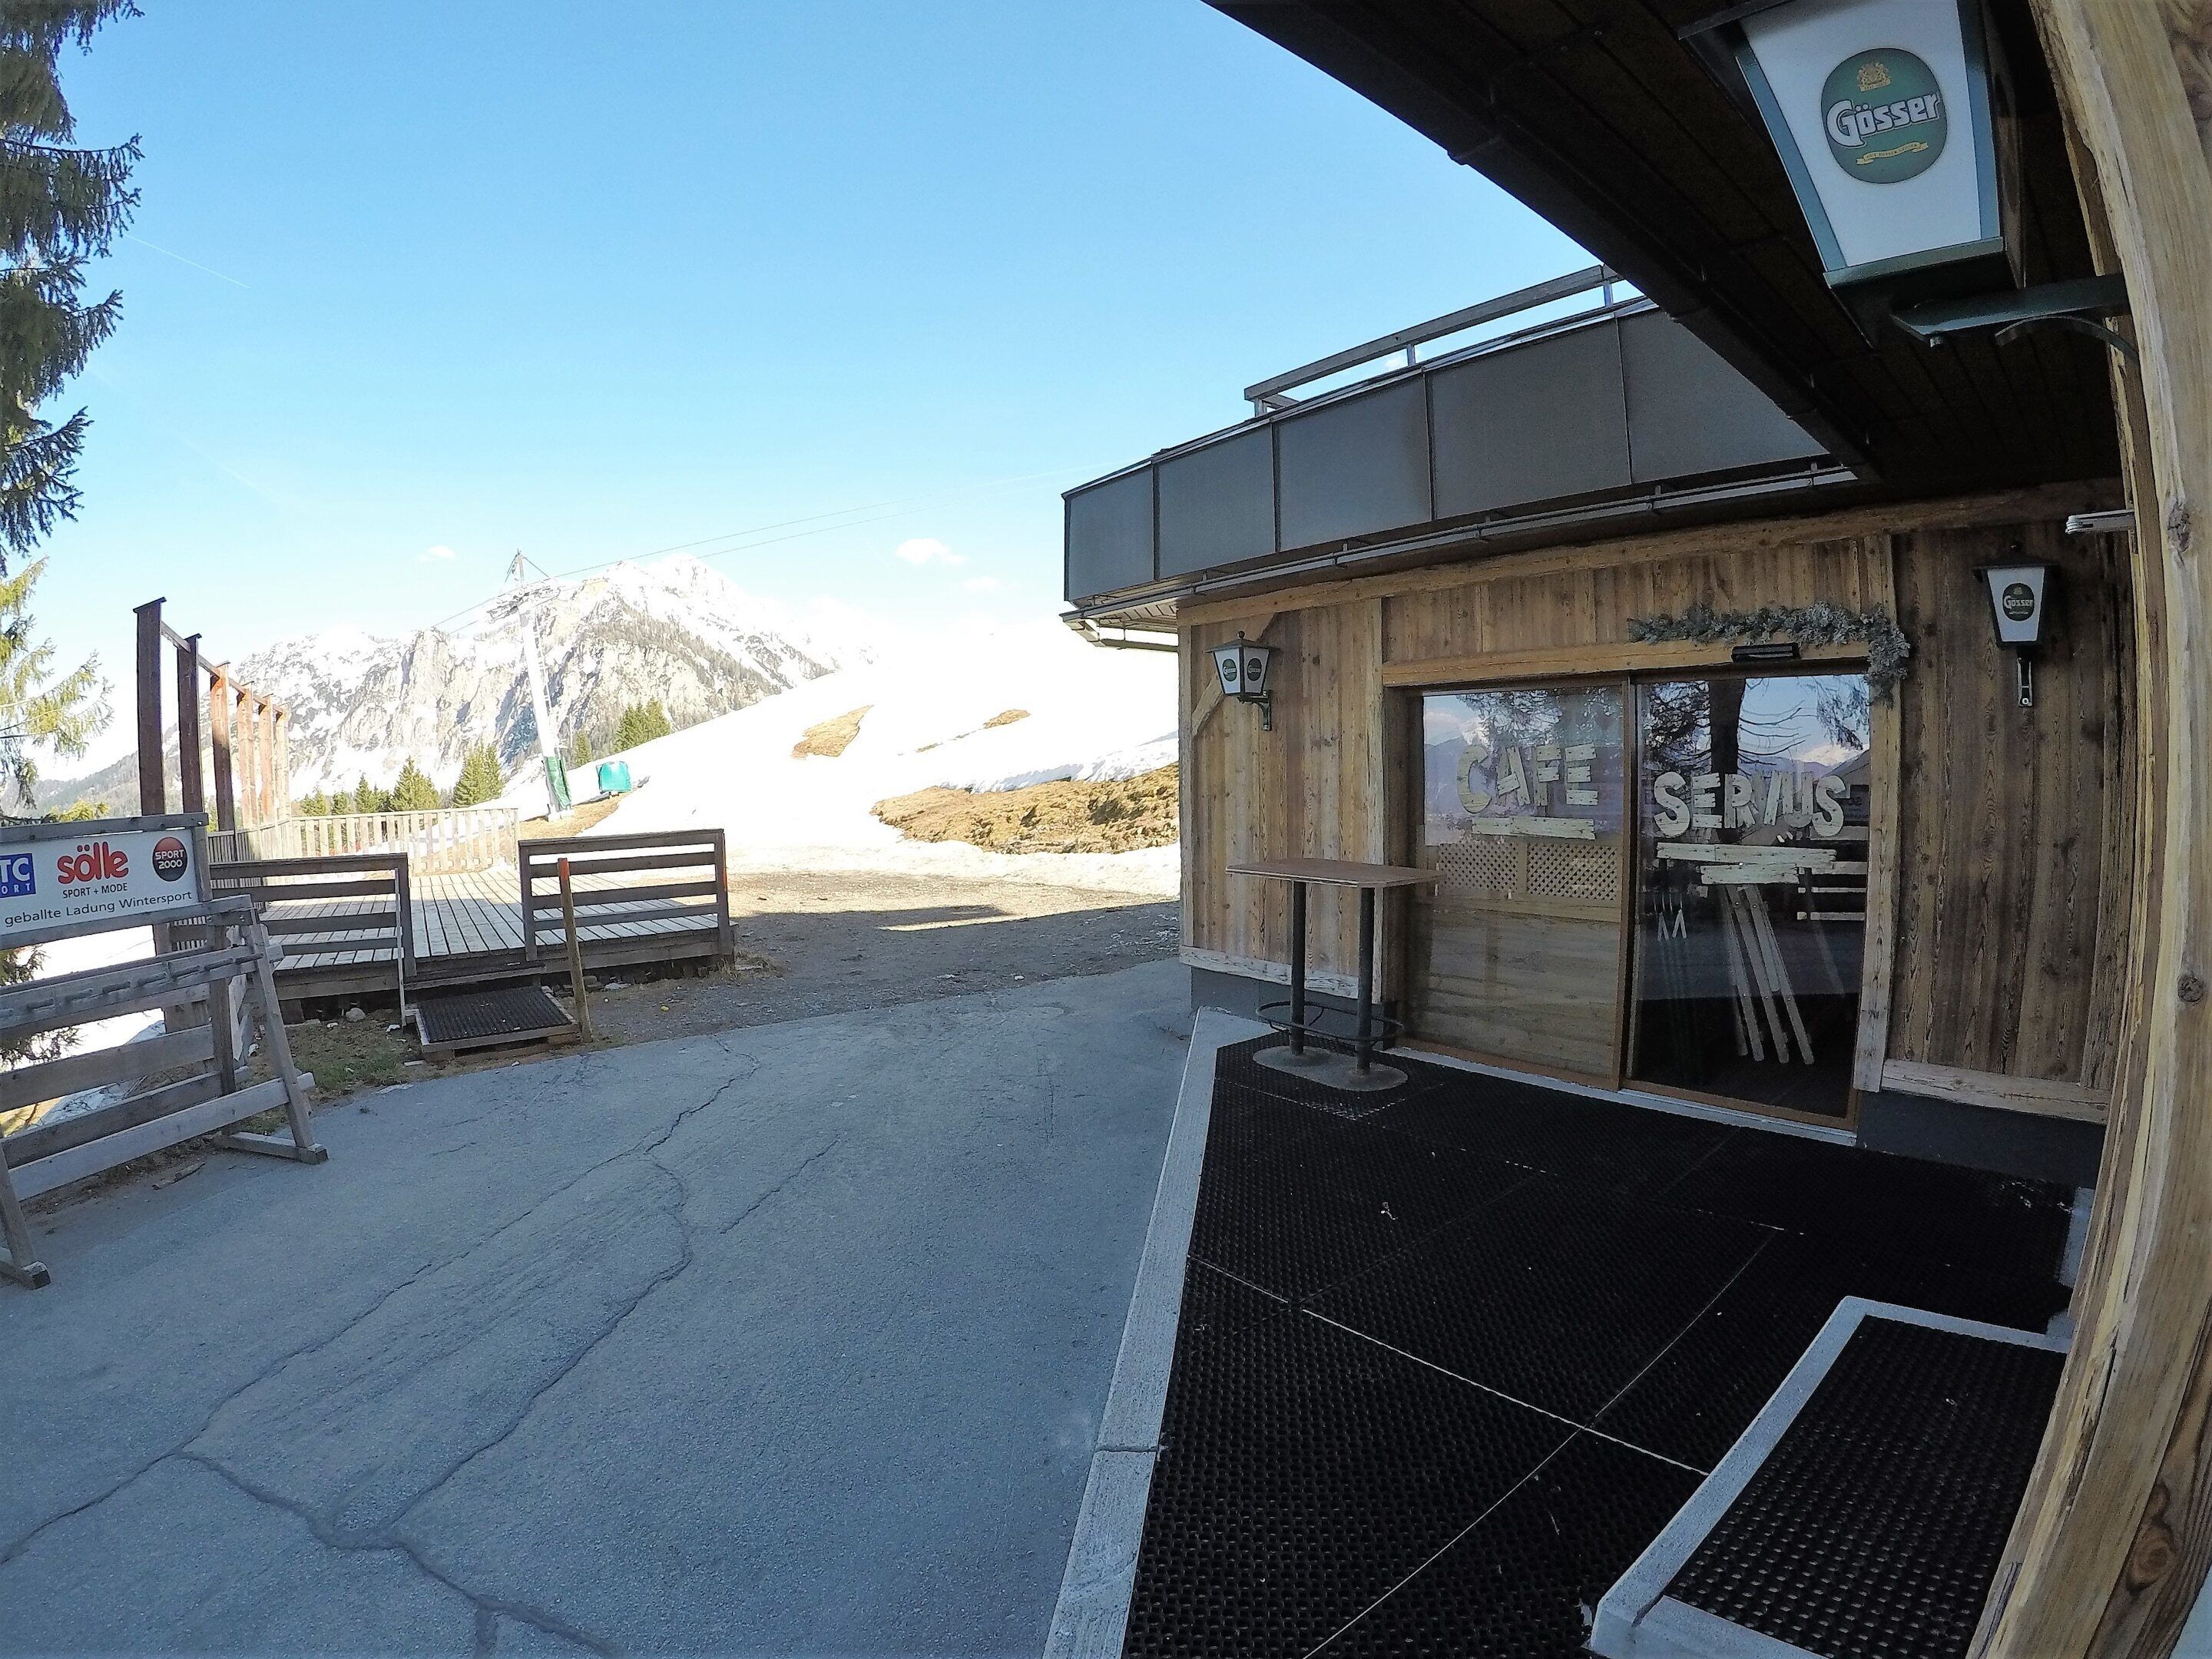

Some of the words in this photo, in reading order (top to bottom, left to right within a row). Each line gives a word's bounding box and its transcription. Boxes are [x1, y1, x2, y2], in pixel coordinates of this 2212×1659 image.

[1826, 93, 1941, 148] Gösser
[1457, 743, 1598, 813] CAFE
[1654, 771, 1846, 837] SERVUS
[58, 841, 129, 884] sölle
[154, 848, 185, 860] SPORT
[158, 859, 183, 869] 2000
[5, 909, 61, 928] geballte
[66, 901, 115, 917] Ladung
[119, 890, 193, 909] Wintersport
[62, 886, 91, 899] SPORT
[101, 882, 128, 894] MODE
